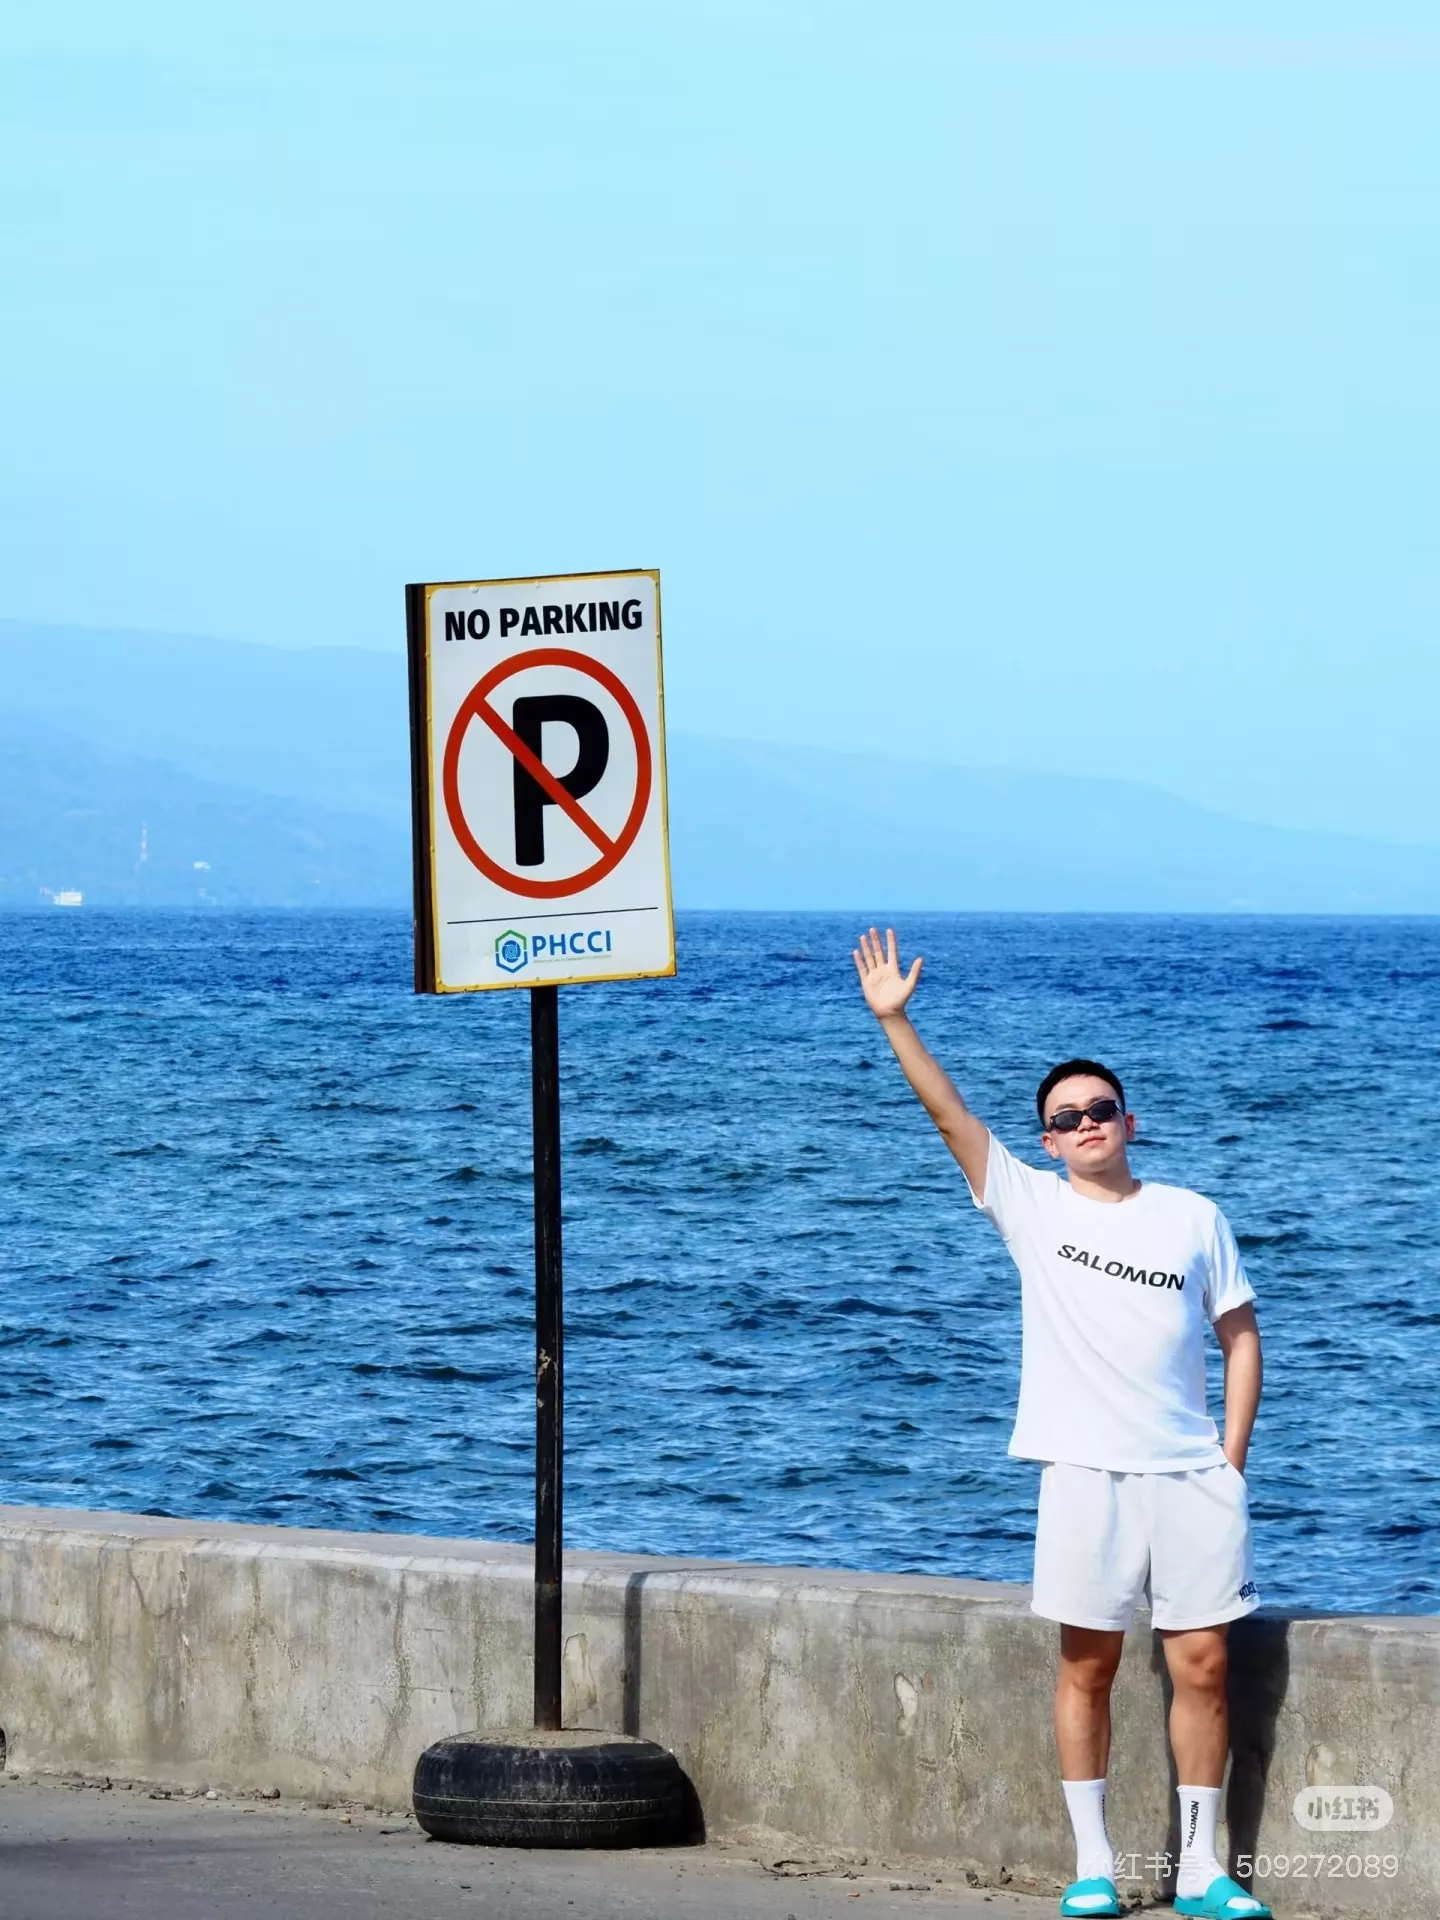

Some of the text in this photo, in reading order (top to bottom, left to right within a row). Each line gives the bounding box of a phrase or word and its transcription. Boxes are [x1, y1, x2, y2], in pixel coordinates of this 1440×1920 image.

[444, 599, 642, 641] NO PARKING
[513, 695, 609, 866] P
[532, 930, 611, 957] PHCCI
[1057, 1244, 1185, 1291] SALOMON
[1186, 1800, 1200, 1848] SALOMON
